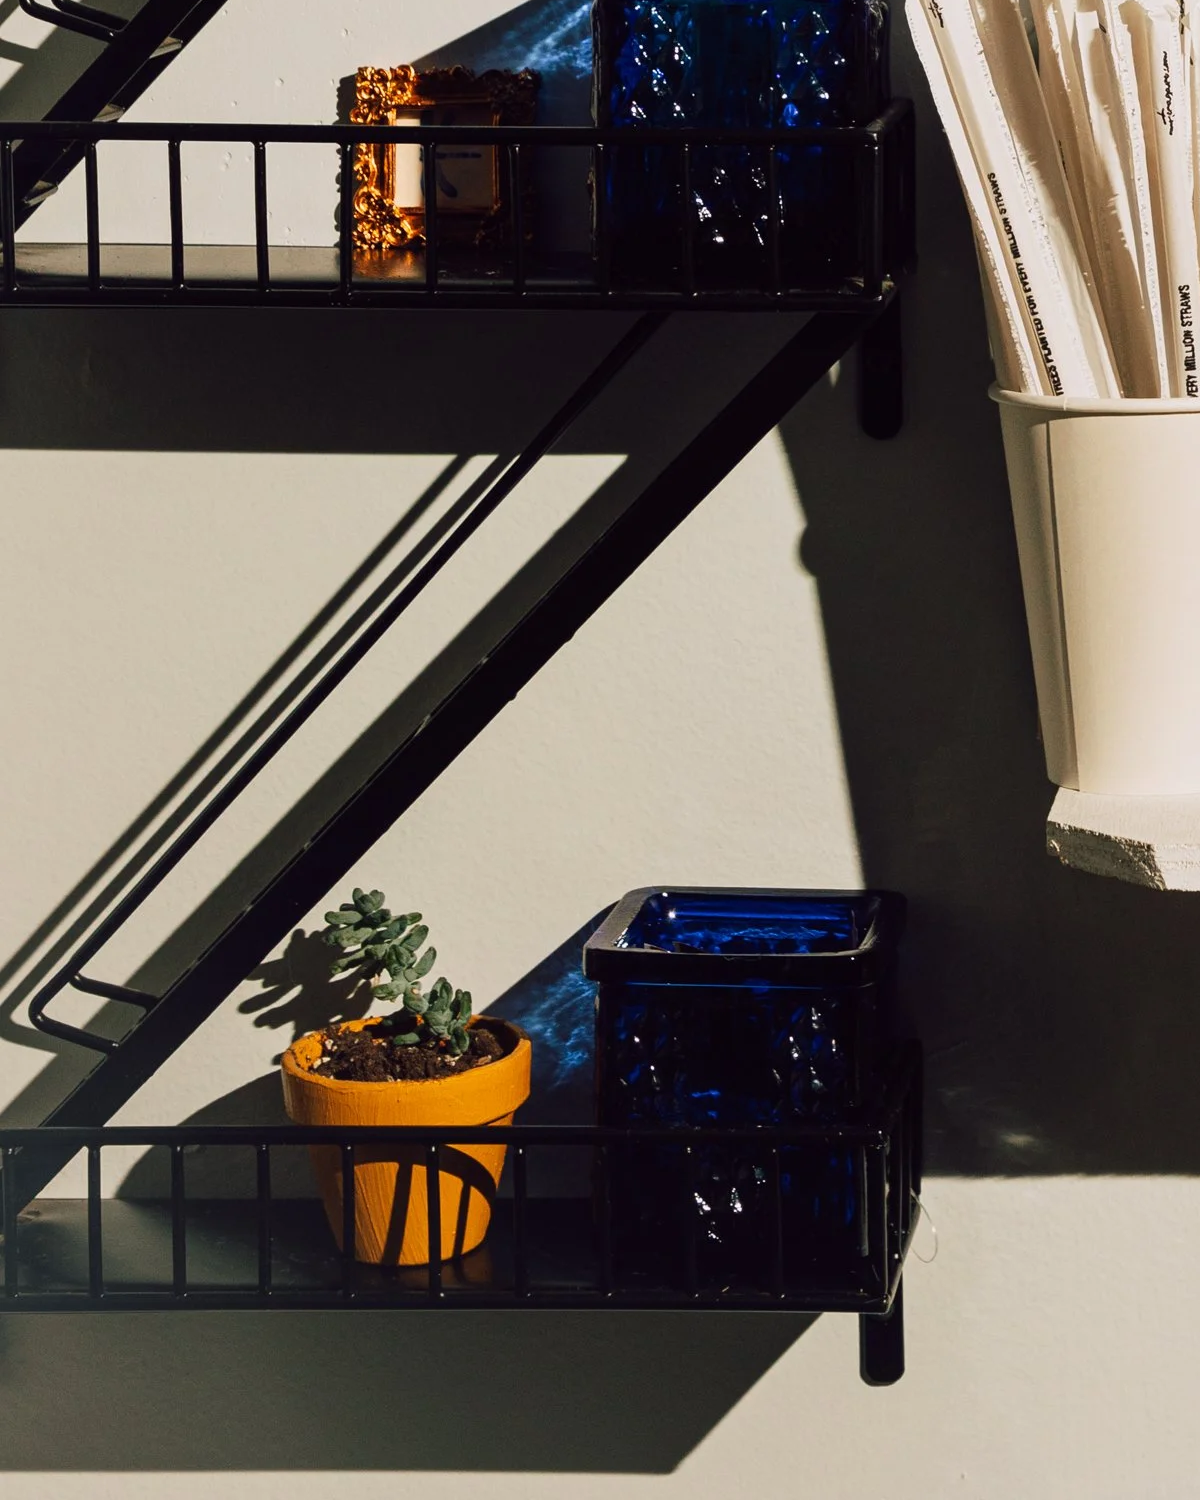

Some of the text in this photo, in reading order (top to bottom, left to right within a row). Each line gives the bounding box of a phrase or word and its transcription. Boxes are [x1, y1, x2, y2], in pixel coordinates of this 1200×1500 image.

[987, 172, 1007, 215] STRAWS
[1001, 216, 1021, 259] MILLION
[1015, 262, 1032, 293] EVERY
[1026, 294, 1039, 316] FOR
[1178, 284, 1193, 327] STRAWS
[1033, 317, 1055, 363] PLANTED
[1182, 329, 1197, 371] MILLION
